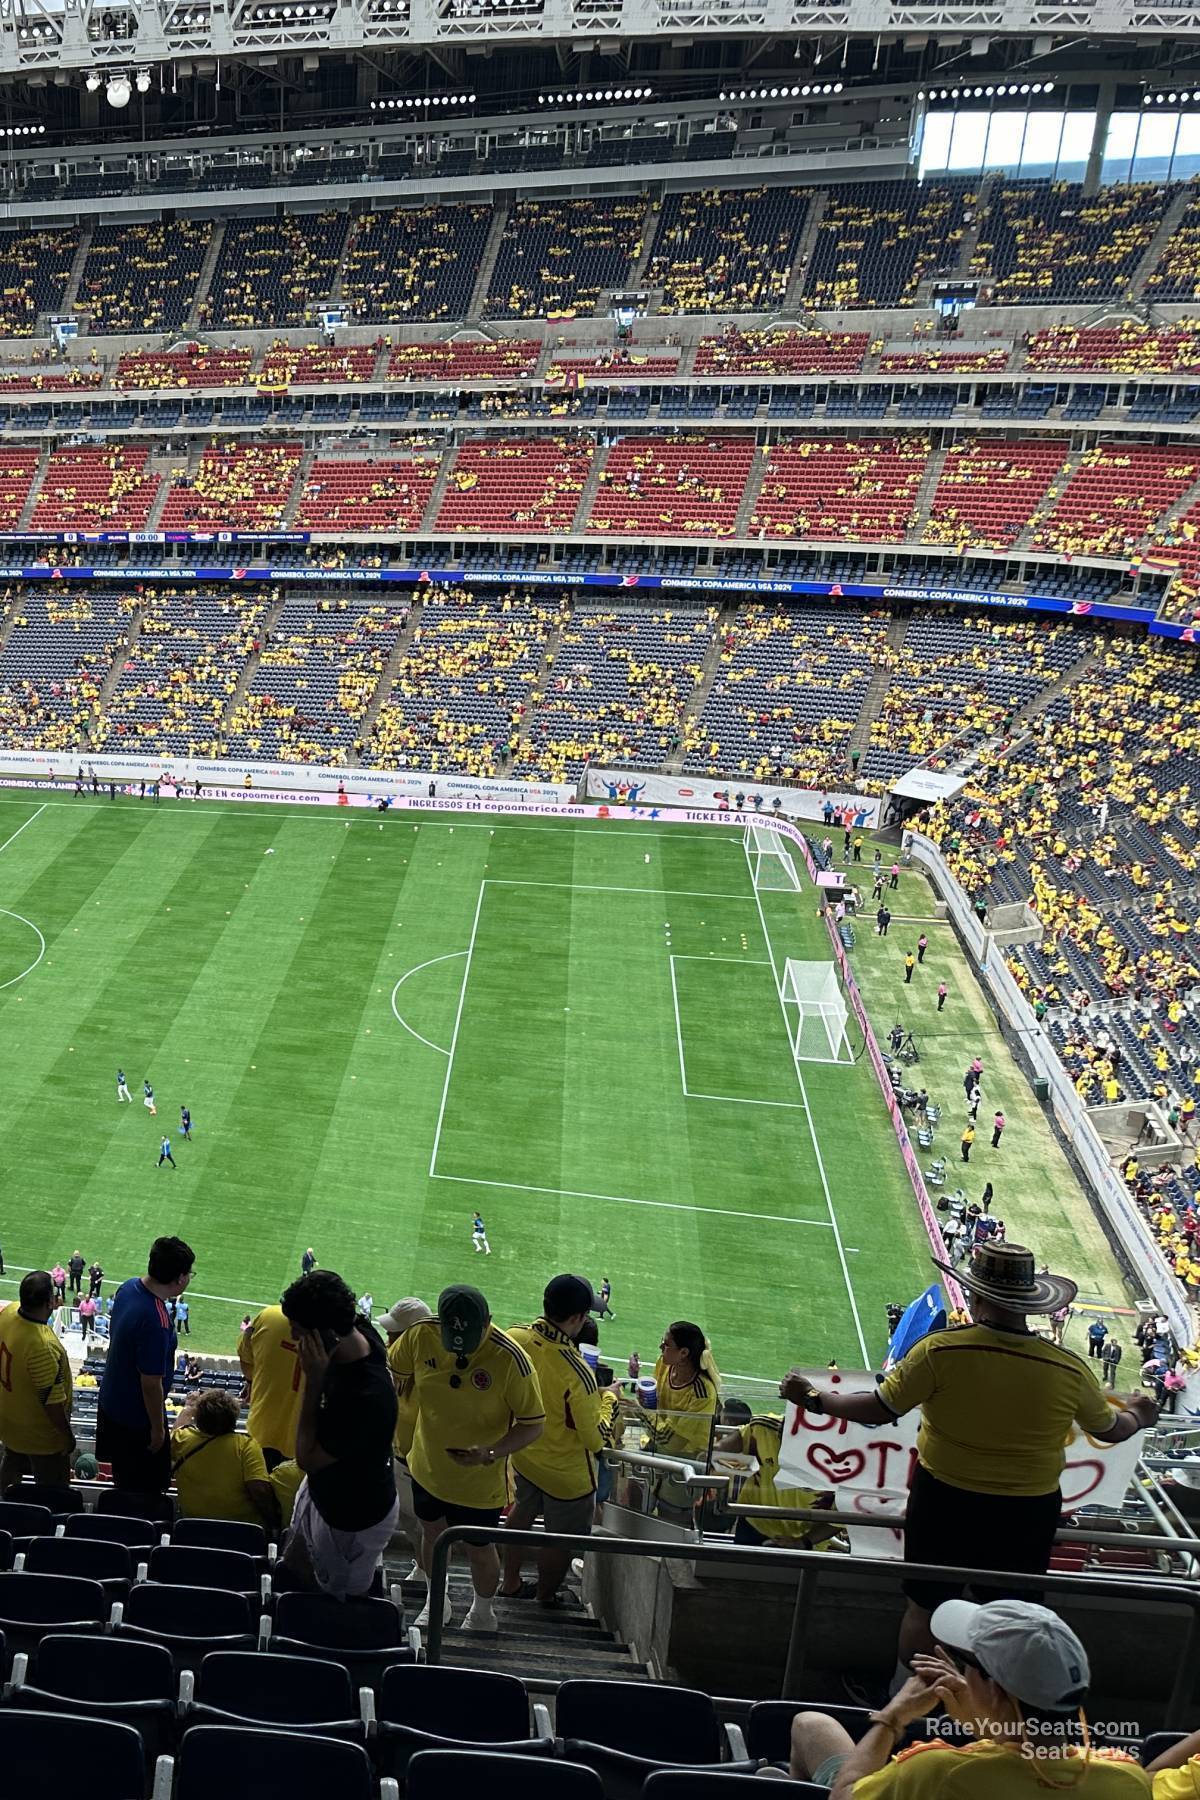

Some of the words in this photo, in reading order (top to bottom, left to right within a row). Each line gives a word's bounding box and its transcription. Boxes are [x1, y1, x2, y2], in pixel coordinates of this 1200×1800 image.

[464, 573, 501, 581] CONMEBOL
[502, 574, 520, 582] COPA
[520, 574, 551, 582] AMERICA
[553, 575, 566, 583] USA
[567, 575, 584, 583] 2024
[661, 579, 700, 588] CONMEBOL
[701, 580, 720, 589] COPA
[721, 581, 756, 590] AMERICA
[758, 582, 771, 590] USA
[774, 583, 792, 591] 2024
[883, 589, 928, 599] CONMEBOL
[930, 592, 951, 601] COPA
[952, 593, 988, 604] AMERICA
[990, 596, 1006, 605] USA
[1008, 597, 1028, 607] 2024
[318, 773, 350, 781] CONMEBOL
[0, 779, 37, 788] CONMEBOL
[38, 781, 56, 789] COPA
[447, 782, 481, 791] CONMEBOL
[500, 786, 528, 794] AMERICA
[543, 788, 558, 796] 2024
[179, 787, 212, 797] ICKTS
[216, 790, 227, 798] EN
[409, 799, 463, 809] INGRESSOS
[466, 802, 480, 810] EM
[686, 812, 730, 822] TICKETS
[735, 814, 746, 823] AT
